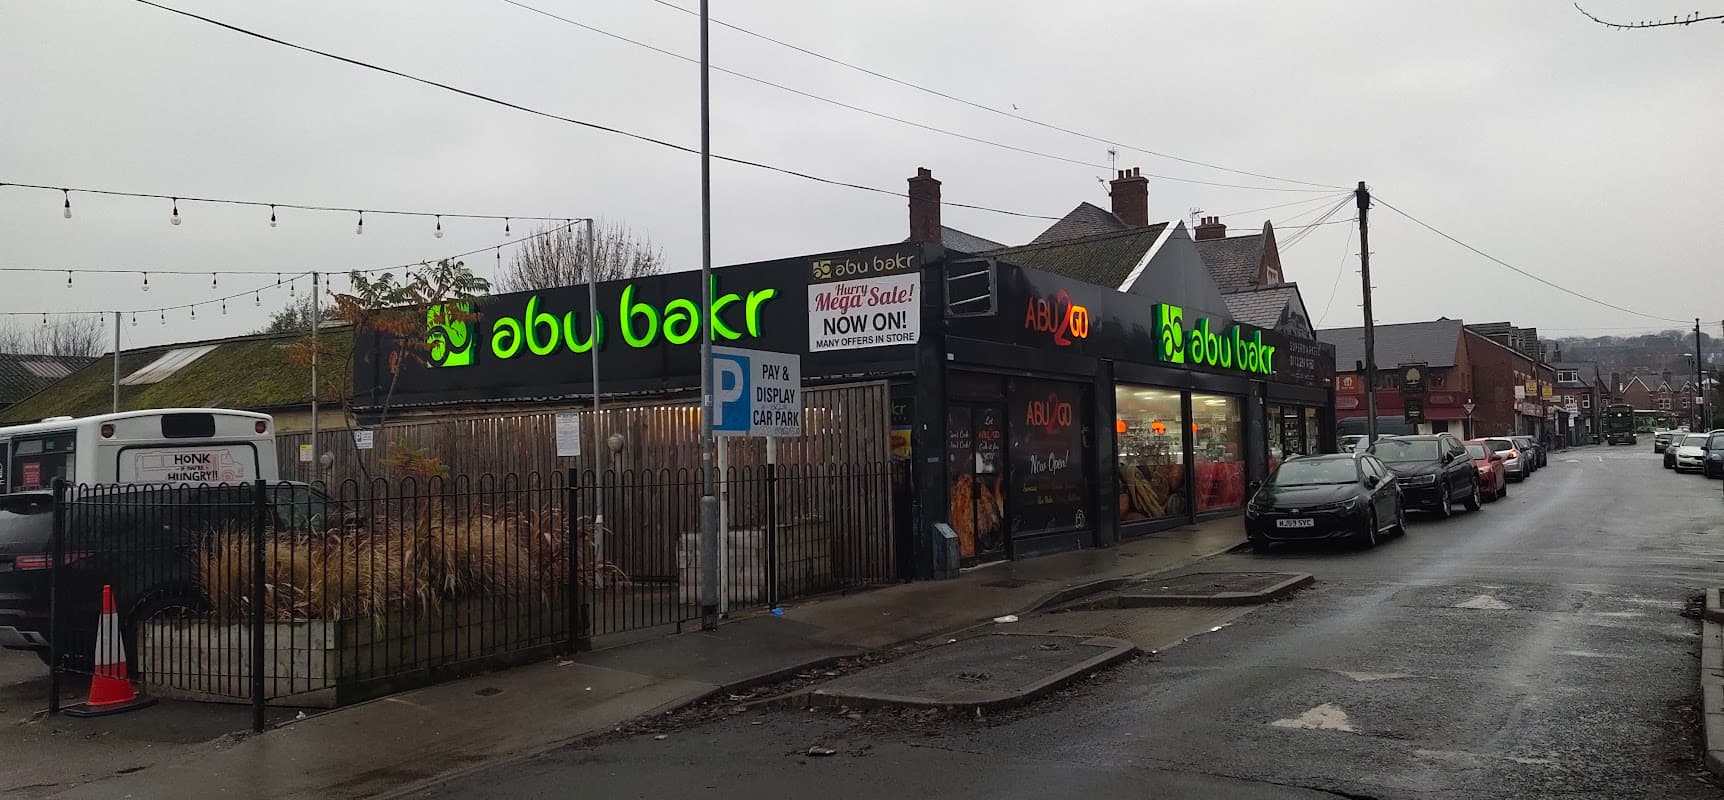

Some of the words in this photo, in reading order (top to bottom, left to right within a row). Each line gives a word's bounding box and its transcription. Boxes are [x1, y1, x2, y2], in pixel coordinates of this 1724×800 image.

[836, 258, 868, 276] abu
[873, 252, 914, 271] bakr
[815, 293, 863, 314] Mega
[868, 284, 915, 306] Sale!
[835, 284, 868, 297] Hurry
[491, 294, 604, 359] abu
[619, 273, 777, 348] bakr
[823, 315, 868, 335] NOW
[872, 311, 907, 331] ON!
[1025, 288, 1089, 346] ABU2GO
[816, 338, 840, 348] MANY
[841, 336, 873, 346] OFFERS
[875, 335, 884, 343] IN
[886, 332, 915, 342] STORE
[1189, 317, 1231, 368] abu
[1233, 324, 1275, 375] bakr
[762, 364, 780, 380] PAY
[782, 366, 789, 381] &
[756, 387, 795, 404] DISPLAY
[753, 410, 772, 426] CAR
[775, 411, 799, 426] PARK
[174, 453, 211, 464] HONK
[1030, 454, 1046, 474] Now
[1048, 449, 1070, 475] Open!
[168, 470, 218, 481] HUNGRY!!
